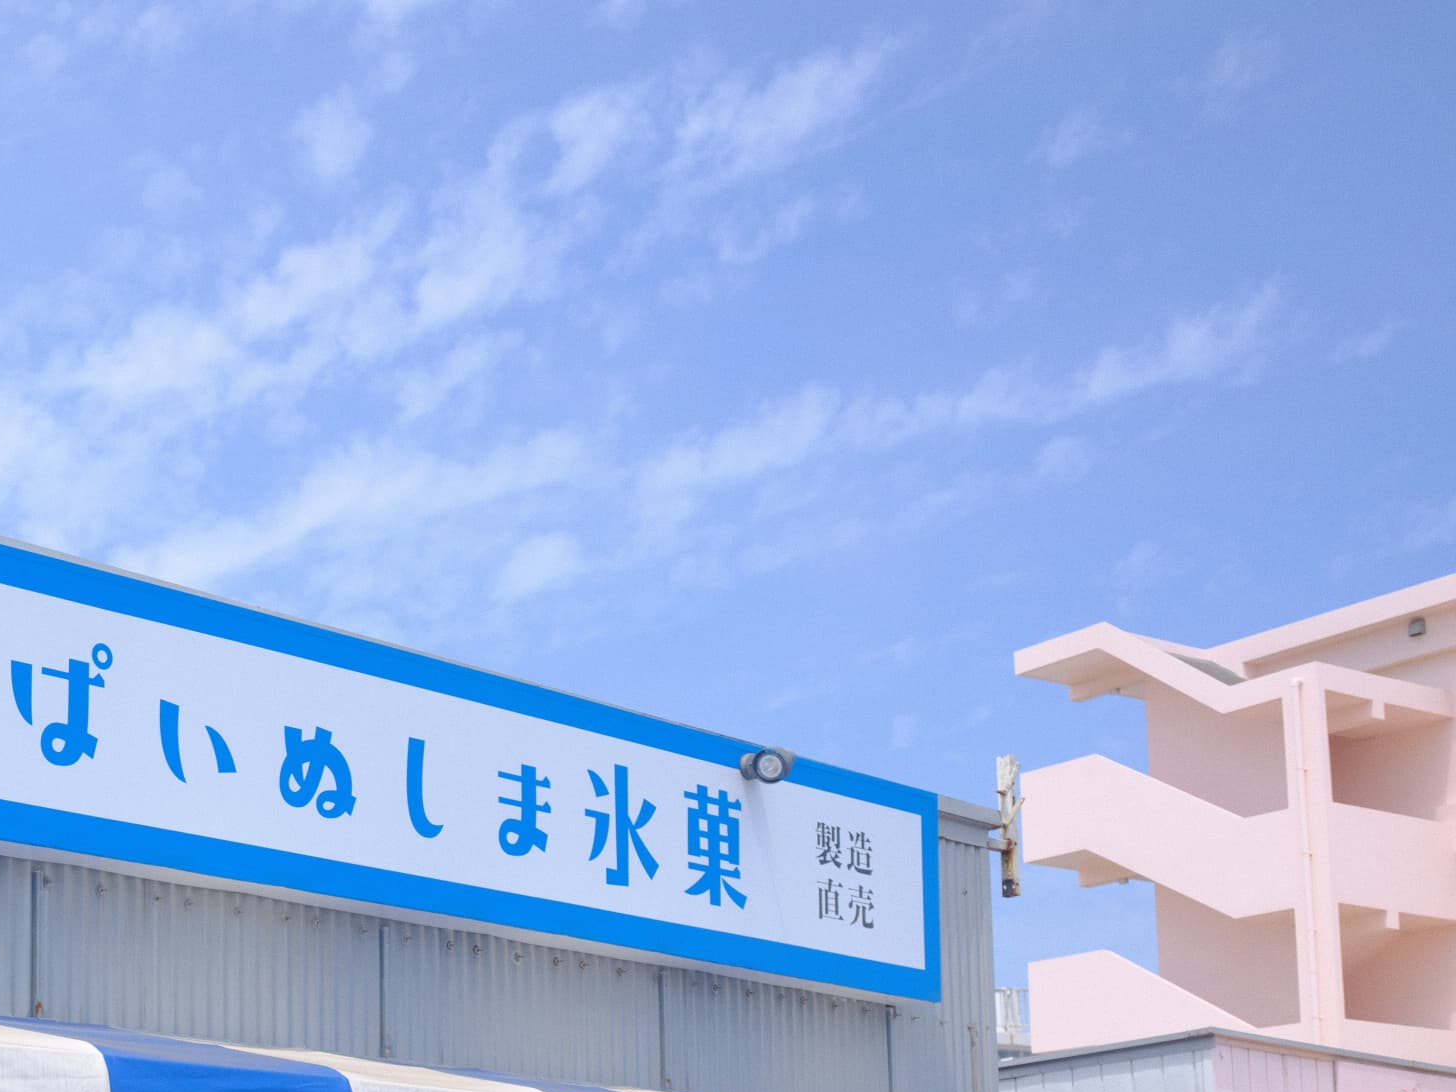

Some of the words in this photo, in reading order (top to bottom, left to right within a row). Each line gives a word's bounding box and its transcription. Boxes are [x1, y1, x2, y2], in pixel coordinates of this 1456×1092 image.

[10, 642, 748, 911] ぱいぬしま氷菓
[816, 821, 873, 876] 製造
[816, 878, 875, 929] 直売
